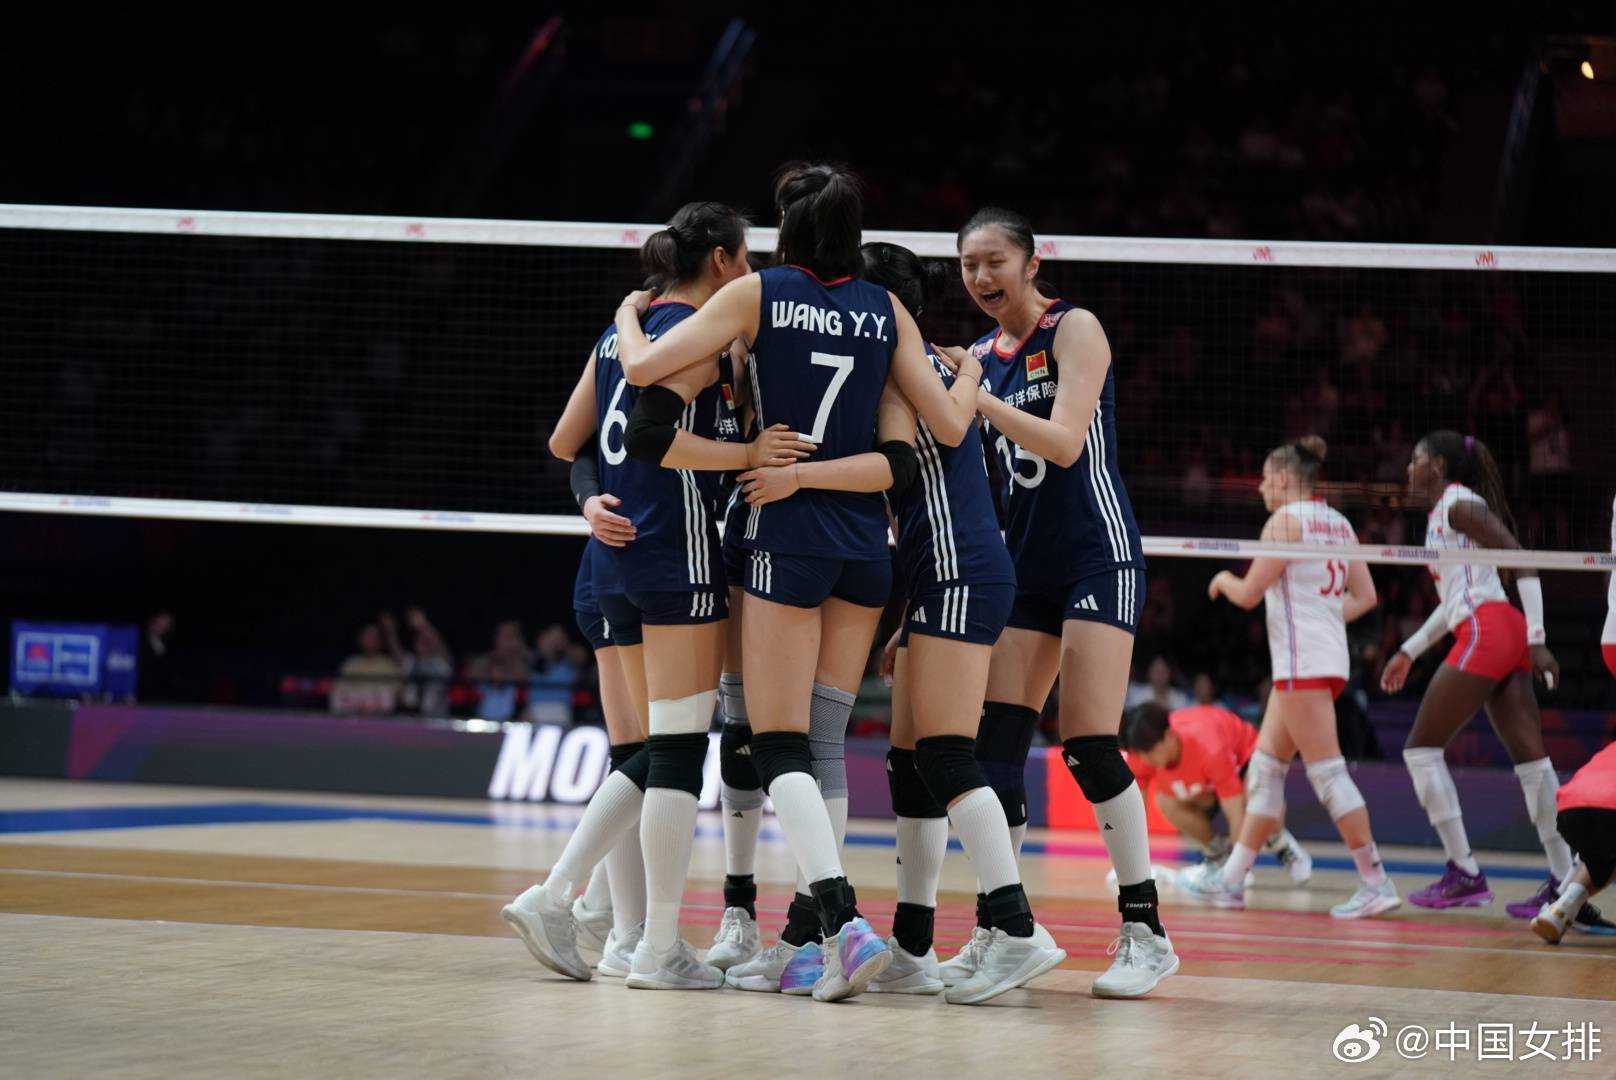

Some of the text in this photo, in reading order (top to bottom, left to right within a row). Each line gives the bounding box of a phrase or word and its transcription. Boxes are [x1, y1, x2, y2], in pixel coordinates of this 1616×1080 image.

[772, 301, 888, 342] WANG Y.Y.
[600, 377, 628, 466] 6
[810, 351, 855, 444] 7
[1003, 381, 1058, 408] 平洋保险
